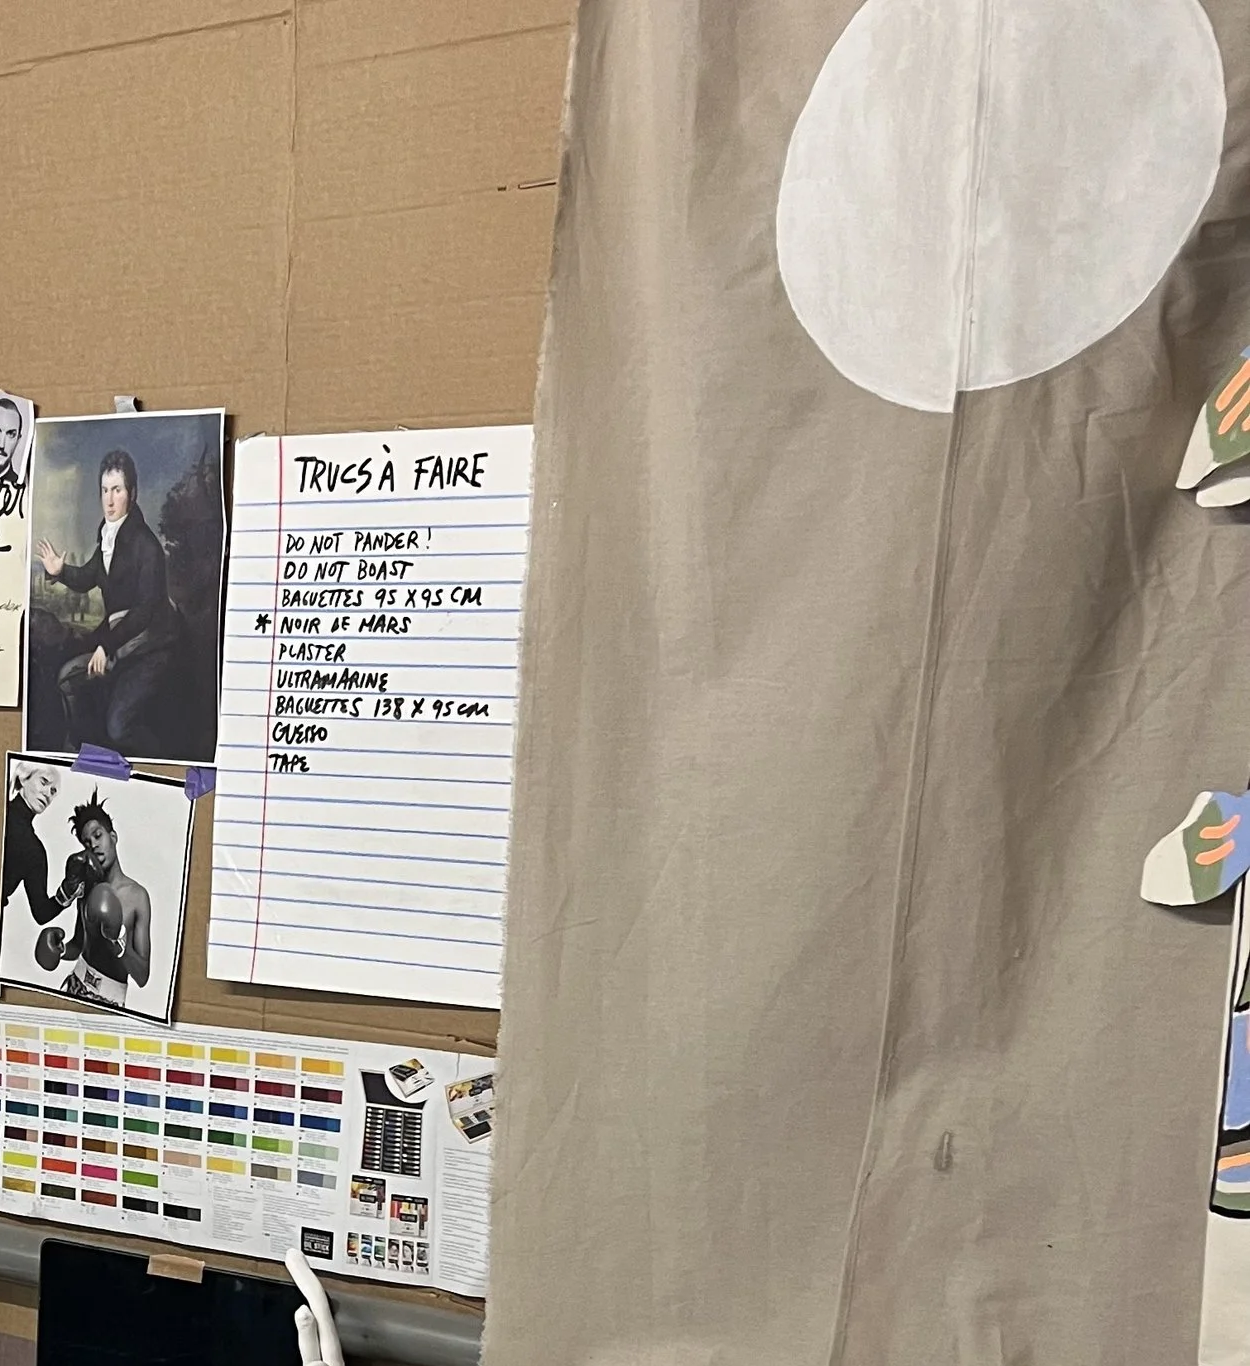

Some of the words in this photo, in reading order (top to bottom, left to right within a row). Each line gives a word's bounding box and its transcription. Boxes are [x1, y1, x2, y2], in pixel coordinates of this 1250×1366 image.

[294, 456, 372, 494] TRUCS
[378, 444, 395, 492] À
[414, 452, 488, 490] FAIRE
[286, 533, 305, 553] DO
[310, 532, 343, 554] NOT
[284, 562, 307, 581] DO
[314, 561, 349, 583] NOT
[357, 560, 413, 581] BOAST
[281, 588, 363, 608] BAGUETTES
[375, 588, 398, 608] 95
[451, 586, 482, 606] CM
[280, 616, 320, 635] NOIR
[331, 616, 350, 633] DE
[358, 614, 411, 634] MARS
[278, 643, 346, 662] PLASTER
[277, 668, 389, 693] ULTRAMARINE
[275, 696, 363, 717] BAGUETTES
[374, 697, 405, 720] 138
[432, 699, 454, 719] 95
[269, 754, 310, 773] TAPE
